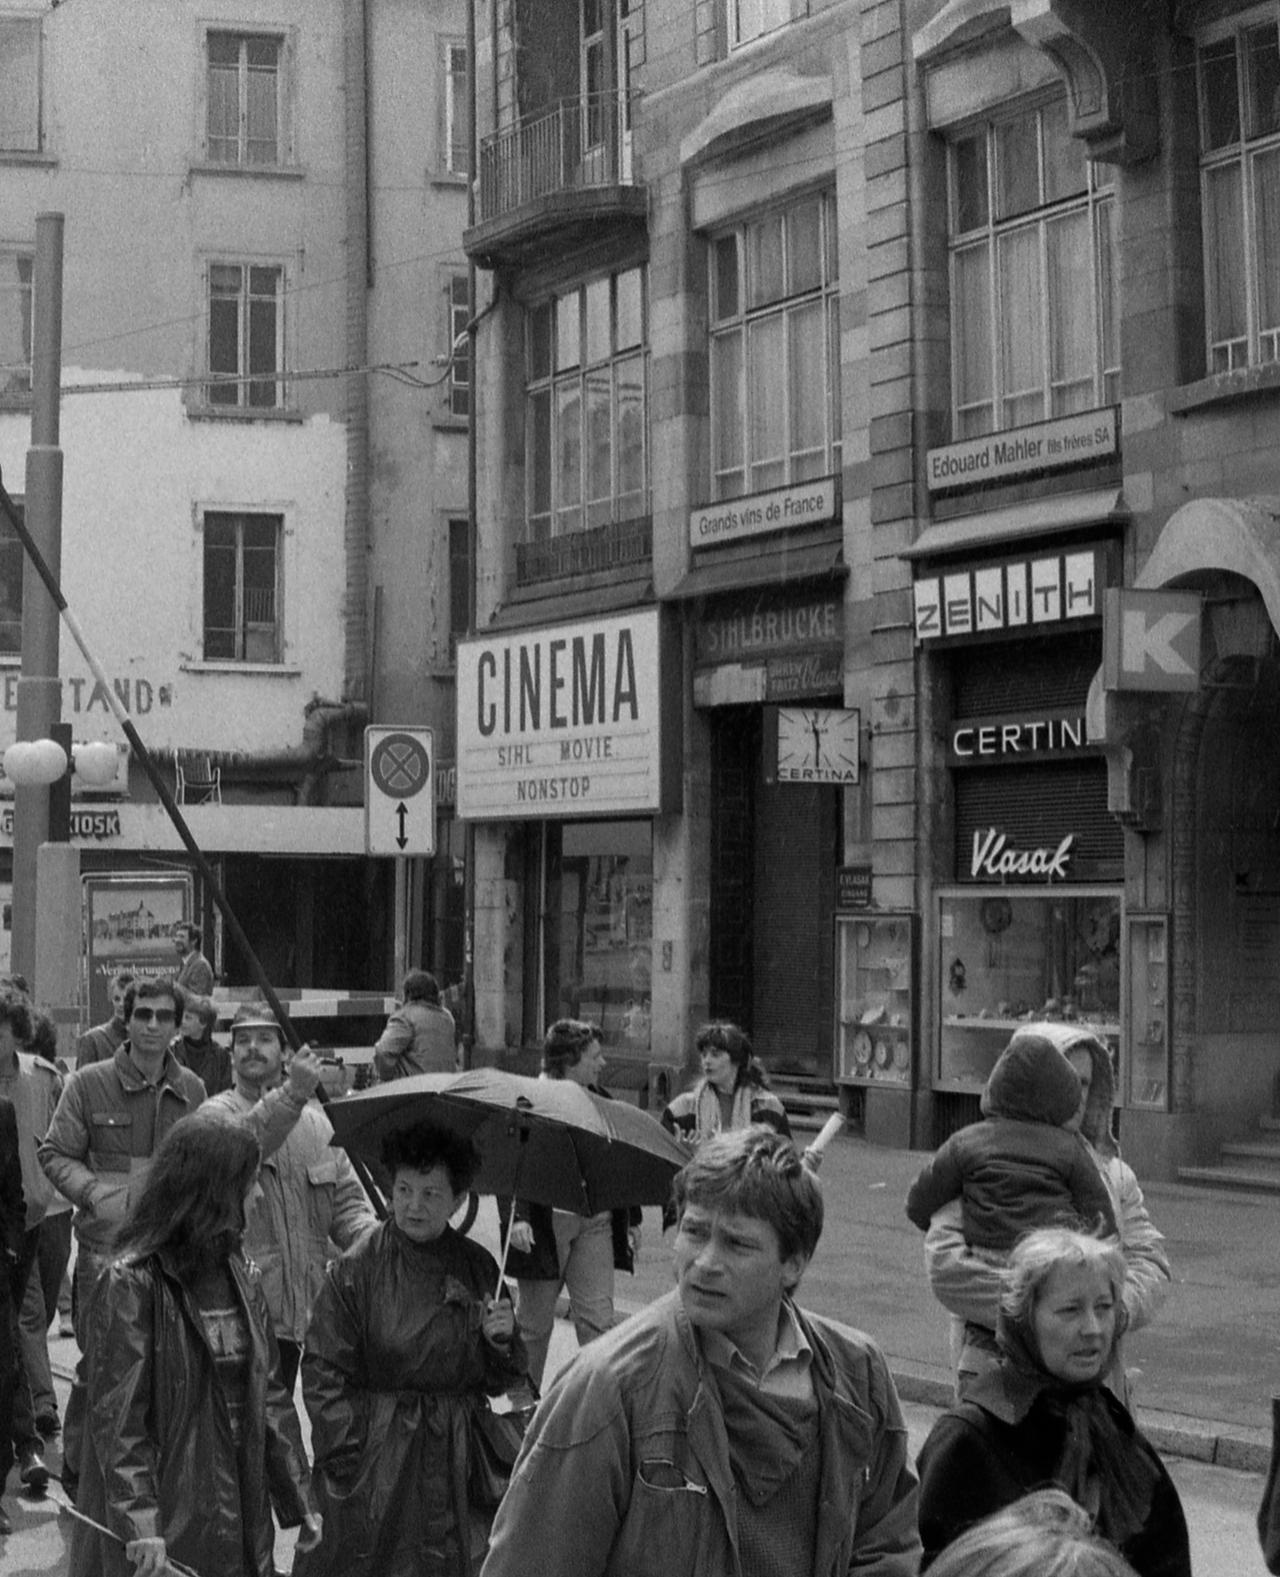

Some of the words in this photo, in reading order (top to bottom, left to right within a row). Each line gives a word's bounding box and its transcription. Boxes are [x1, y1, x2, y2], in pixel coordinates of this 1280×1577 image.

[932, 447, 989, 479] Edouard
[995, 438, 1044, 465] Mahler
[1095, 427, 1109, 444] SA
[699, 512, 738, 536] Grands
[740, 508, 763, 528] vins
[766, 503, 780, 522] de
[784, 495, 824, 518] France
[917, 578, 1093, 632] ZENITH
[1122, 610, 1197, 675] K
[478, 628, 639, 737] CINEMA
[498, 744, 533, 766] SIHL
[560, 736, 613, 761] MOVIE
[953, 718, 1090, 756] CERTIN
[517, 776, 590, 801] NONSTOP
[778, 767, 855, 781] CERTINA
[971, 827, 1074, 878] Vlasak
